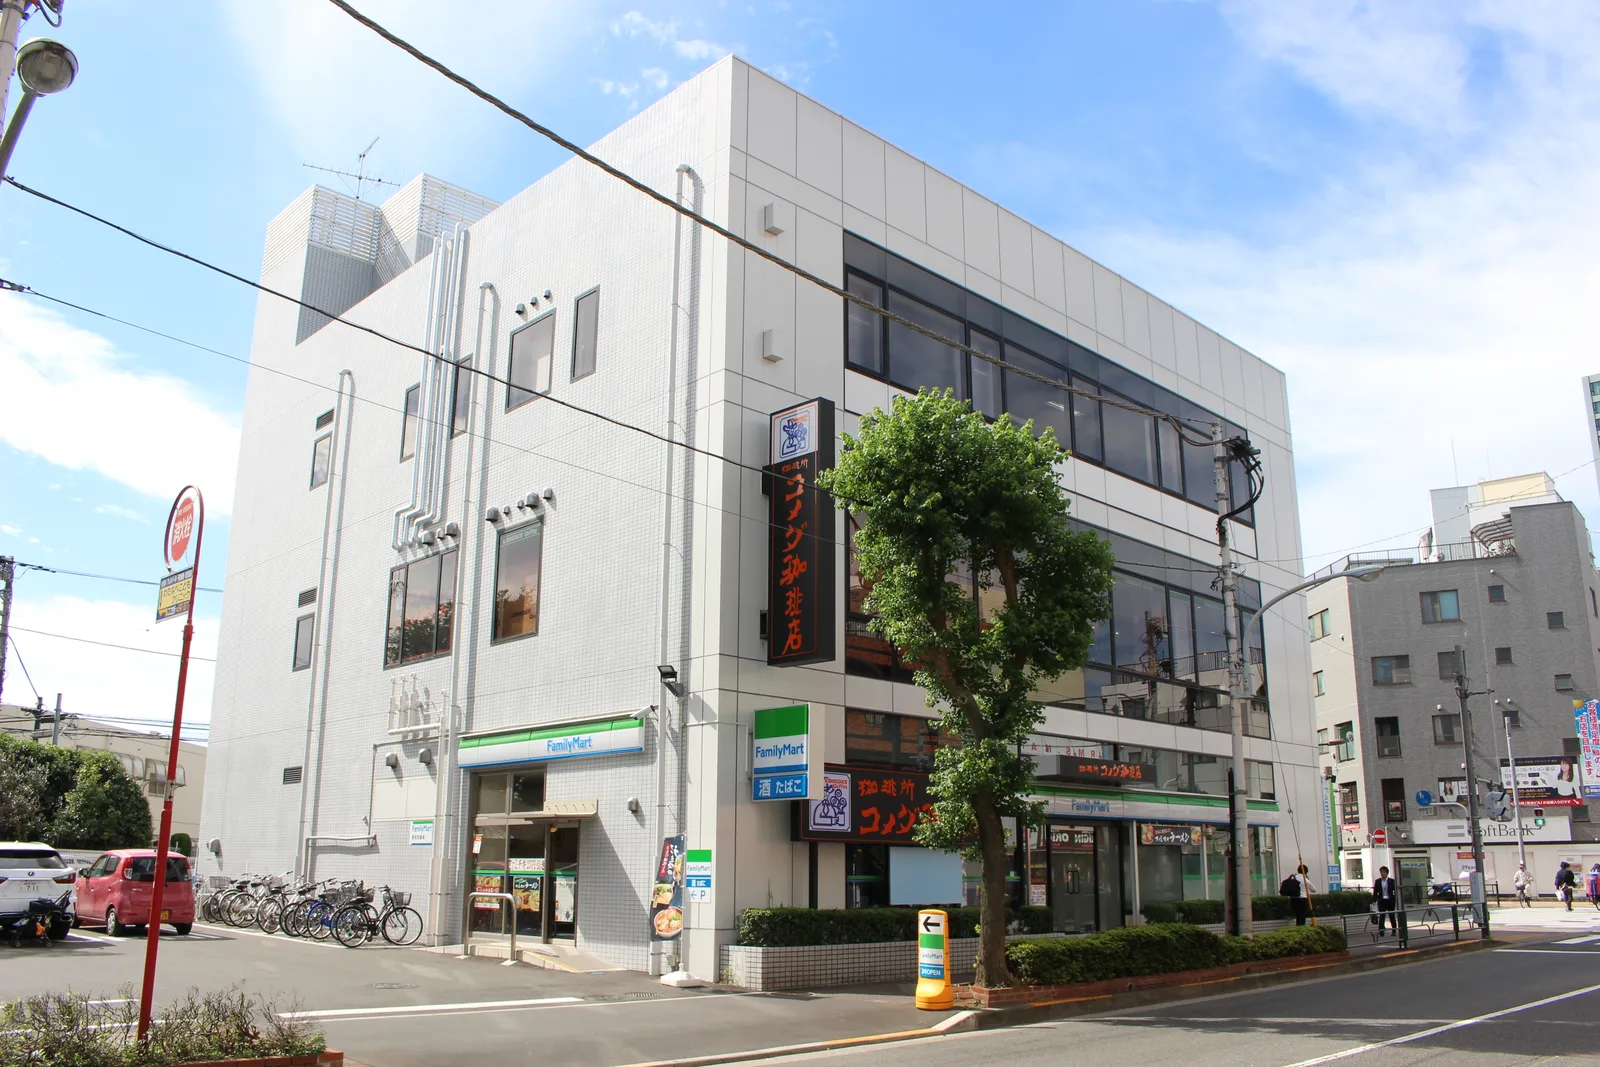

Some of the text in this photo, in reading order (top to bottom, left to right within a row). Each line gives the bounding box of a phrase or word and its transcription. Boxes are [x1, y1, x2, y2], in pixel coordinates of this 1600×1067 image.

[546, 736, 592, 752] FamilyMart
[755, 743, 804, 759] FamilyMart
[758, 779, 802, 796] 酒 たばこ
[858, 778, 915, 801] 珈琲所
[1071, 800, 1110, 814] FamilyMart
[1478, 823, 1534, 837] oftBak
[687, 864, 711, 873] FamilyMart
